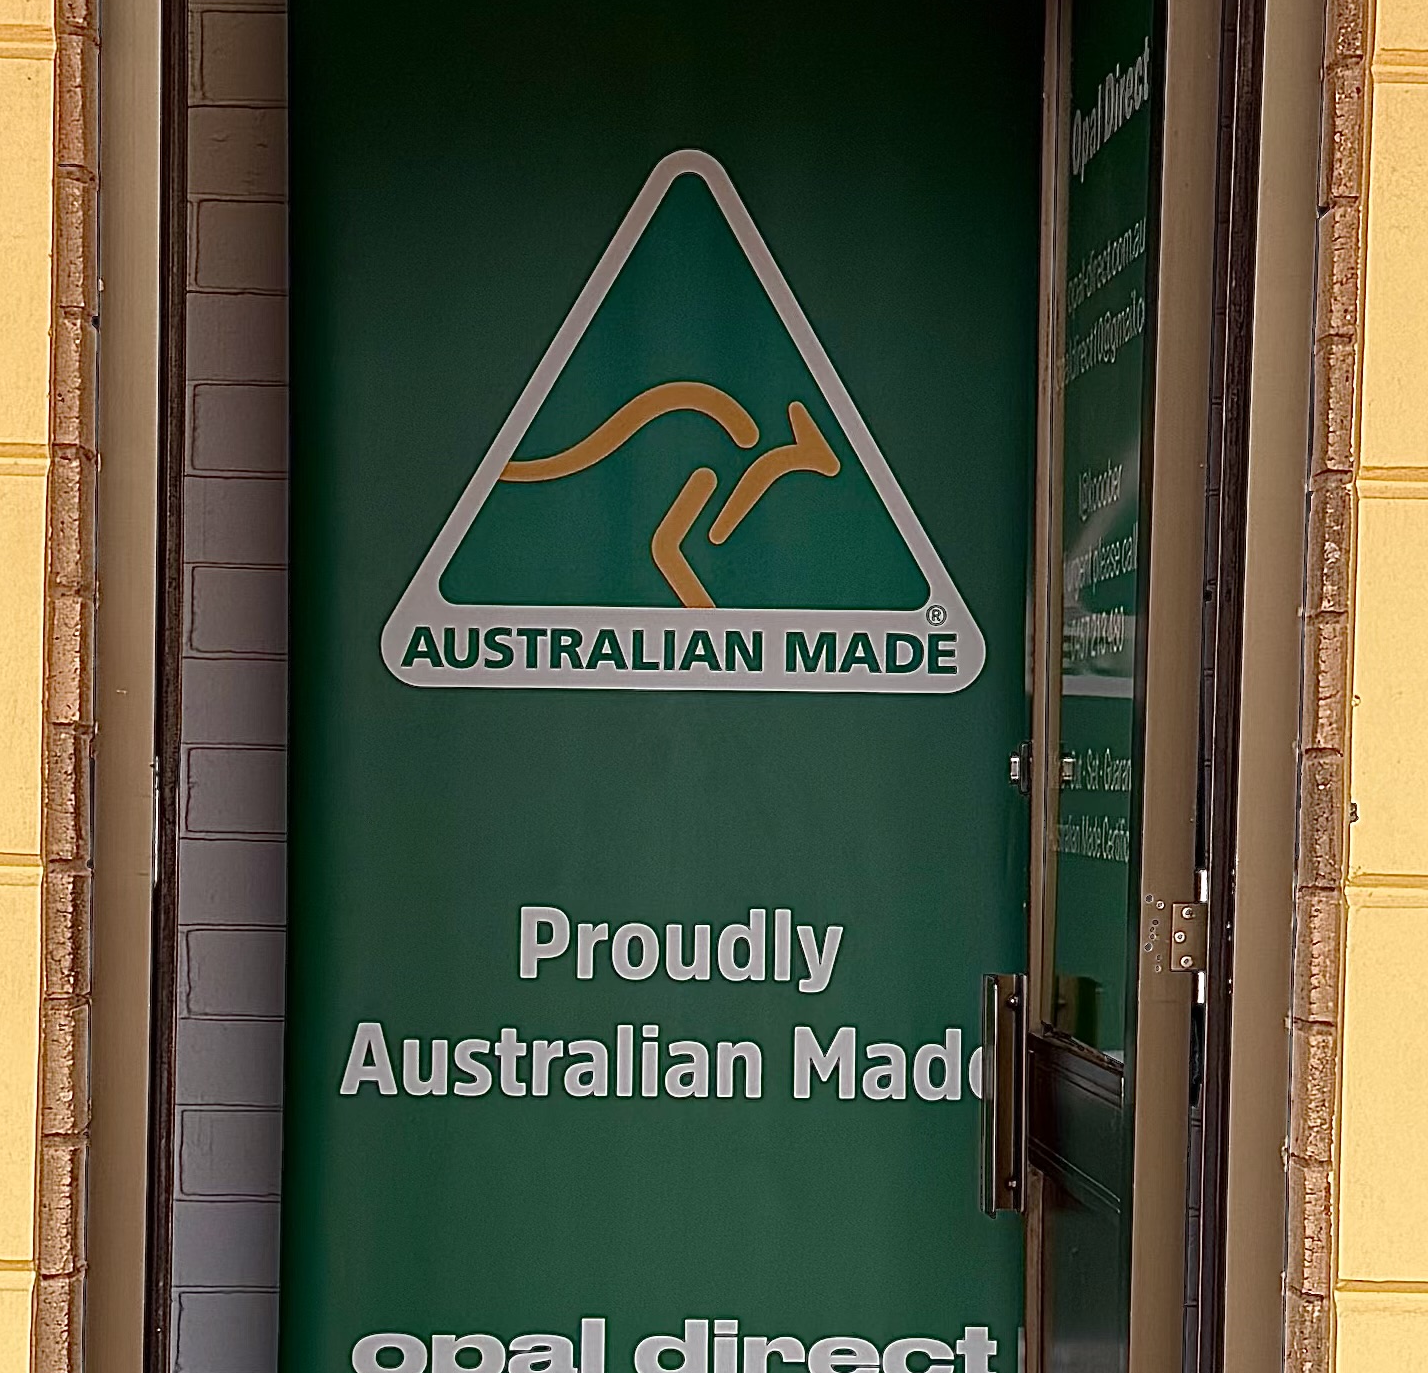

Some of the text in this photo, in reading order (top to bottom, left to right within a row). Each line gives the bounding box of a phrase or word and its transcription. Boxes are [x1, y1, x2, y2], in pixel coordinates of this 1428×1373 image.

[1072, 35, 1150, 184] Opal Direct
[400, 626, 959, 676] AUSTRALIAN MADE
[518, 906, 844, 994] Proudly
[339, 1022, 763, 1100] Australian
